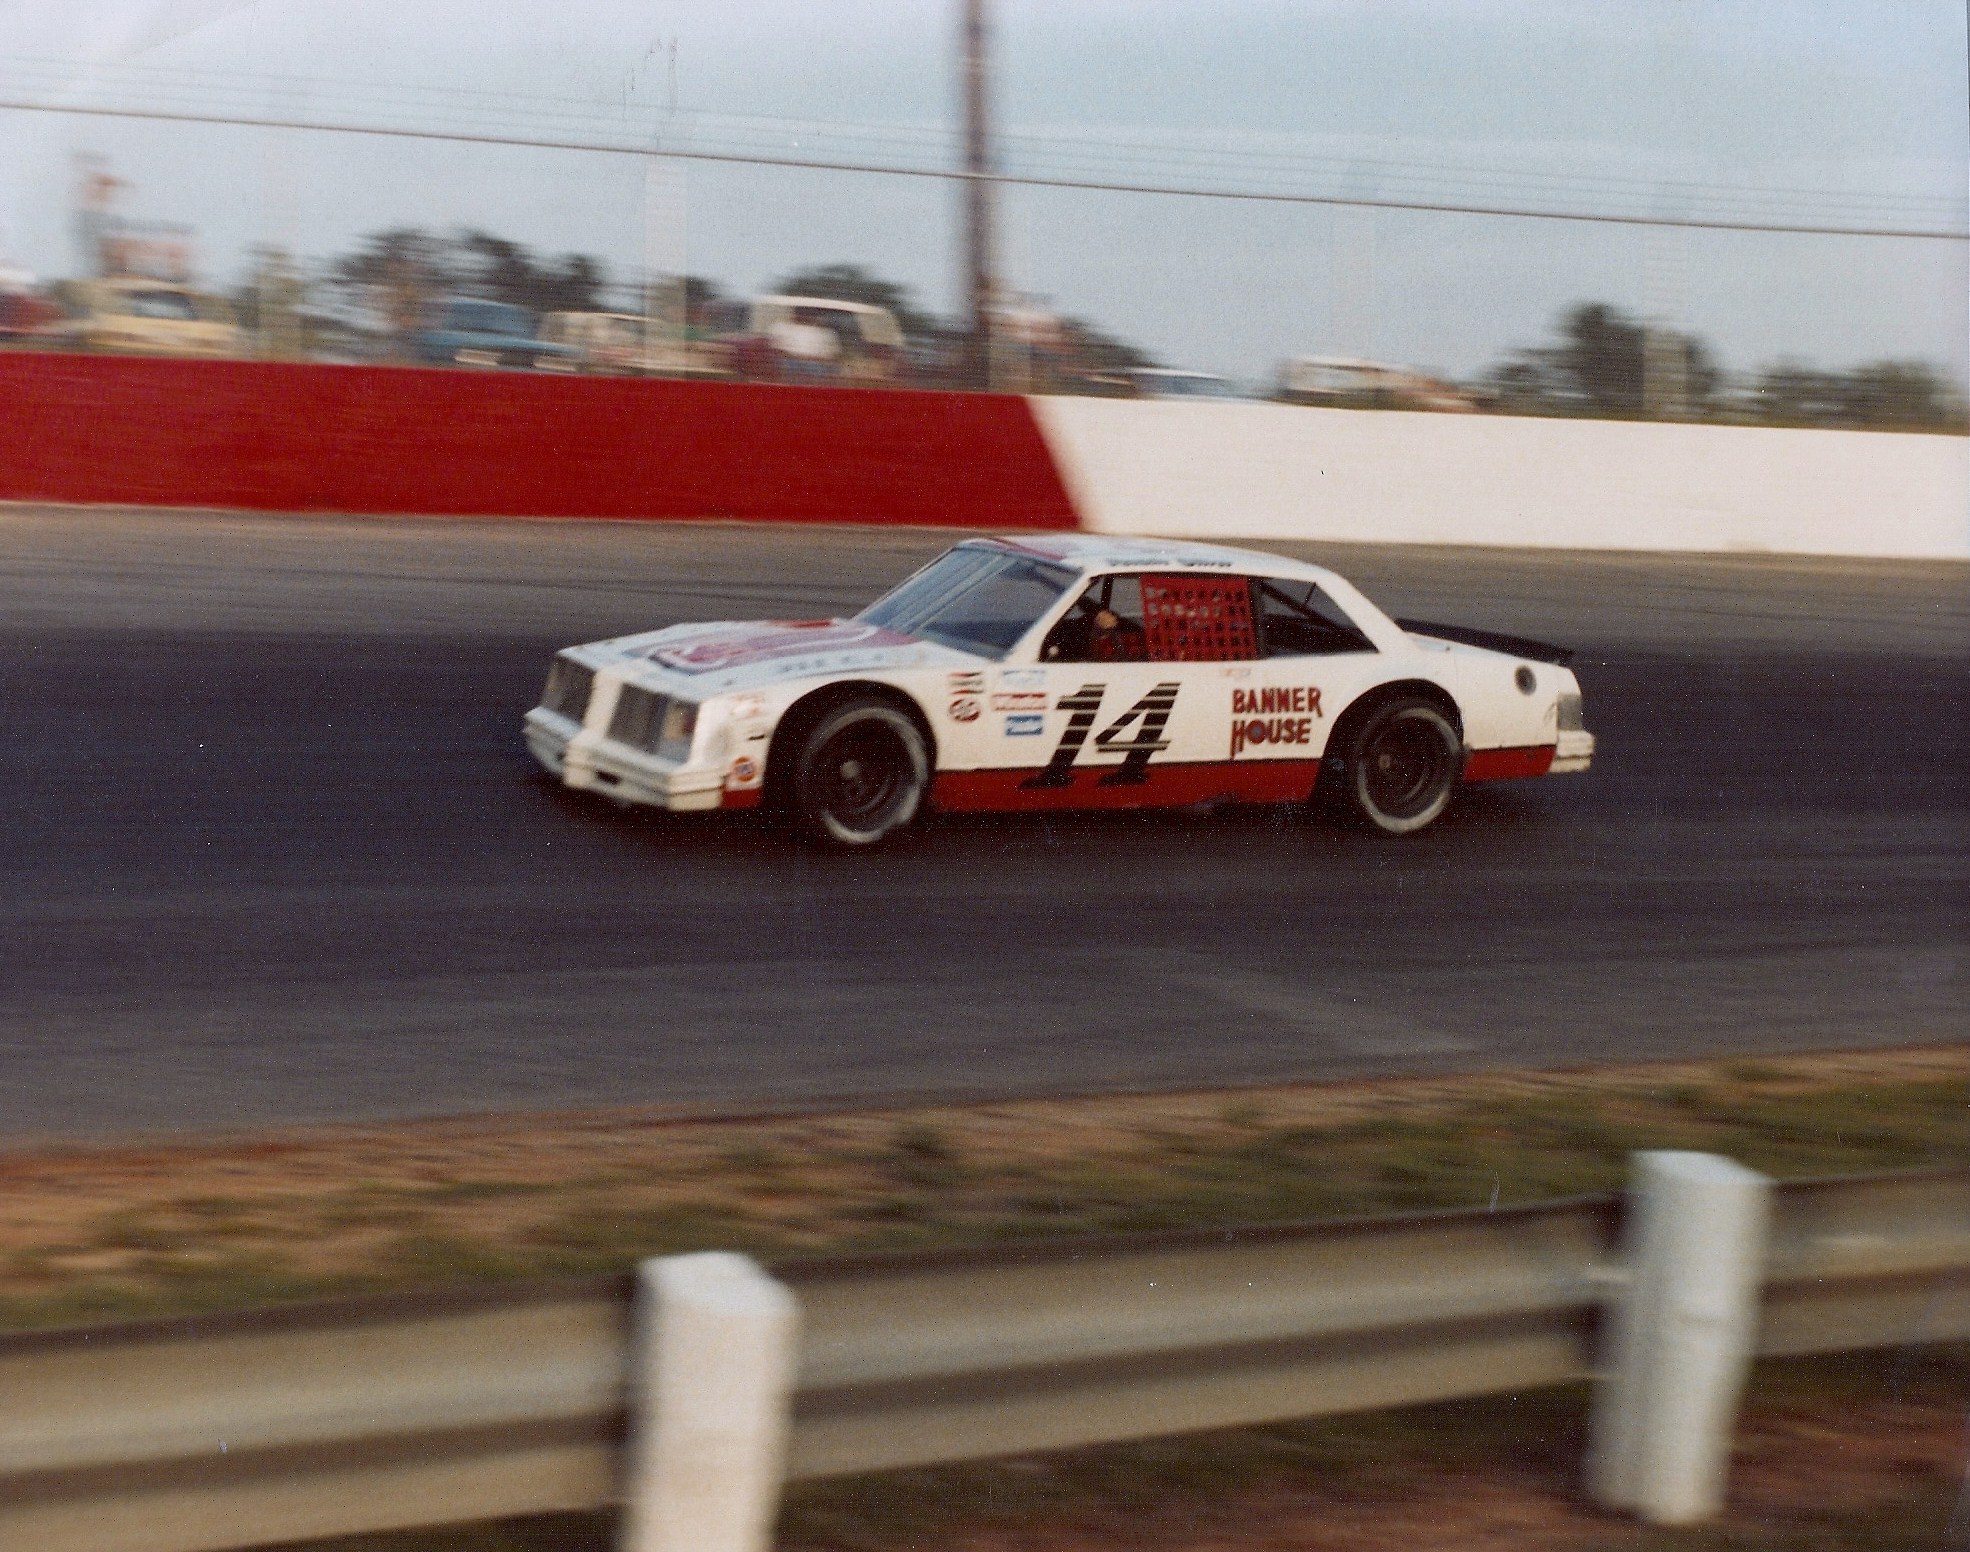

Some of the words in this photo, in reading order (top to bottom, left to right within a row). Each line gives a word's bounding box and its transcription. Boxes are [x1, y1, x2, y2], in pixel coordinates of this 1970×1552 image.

[1232, 687, 1323, 718] BANNER
[1018, 683, 1182, 789] 14
[1230, 718, 1311, 760] HOUSE
